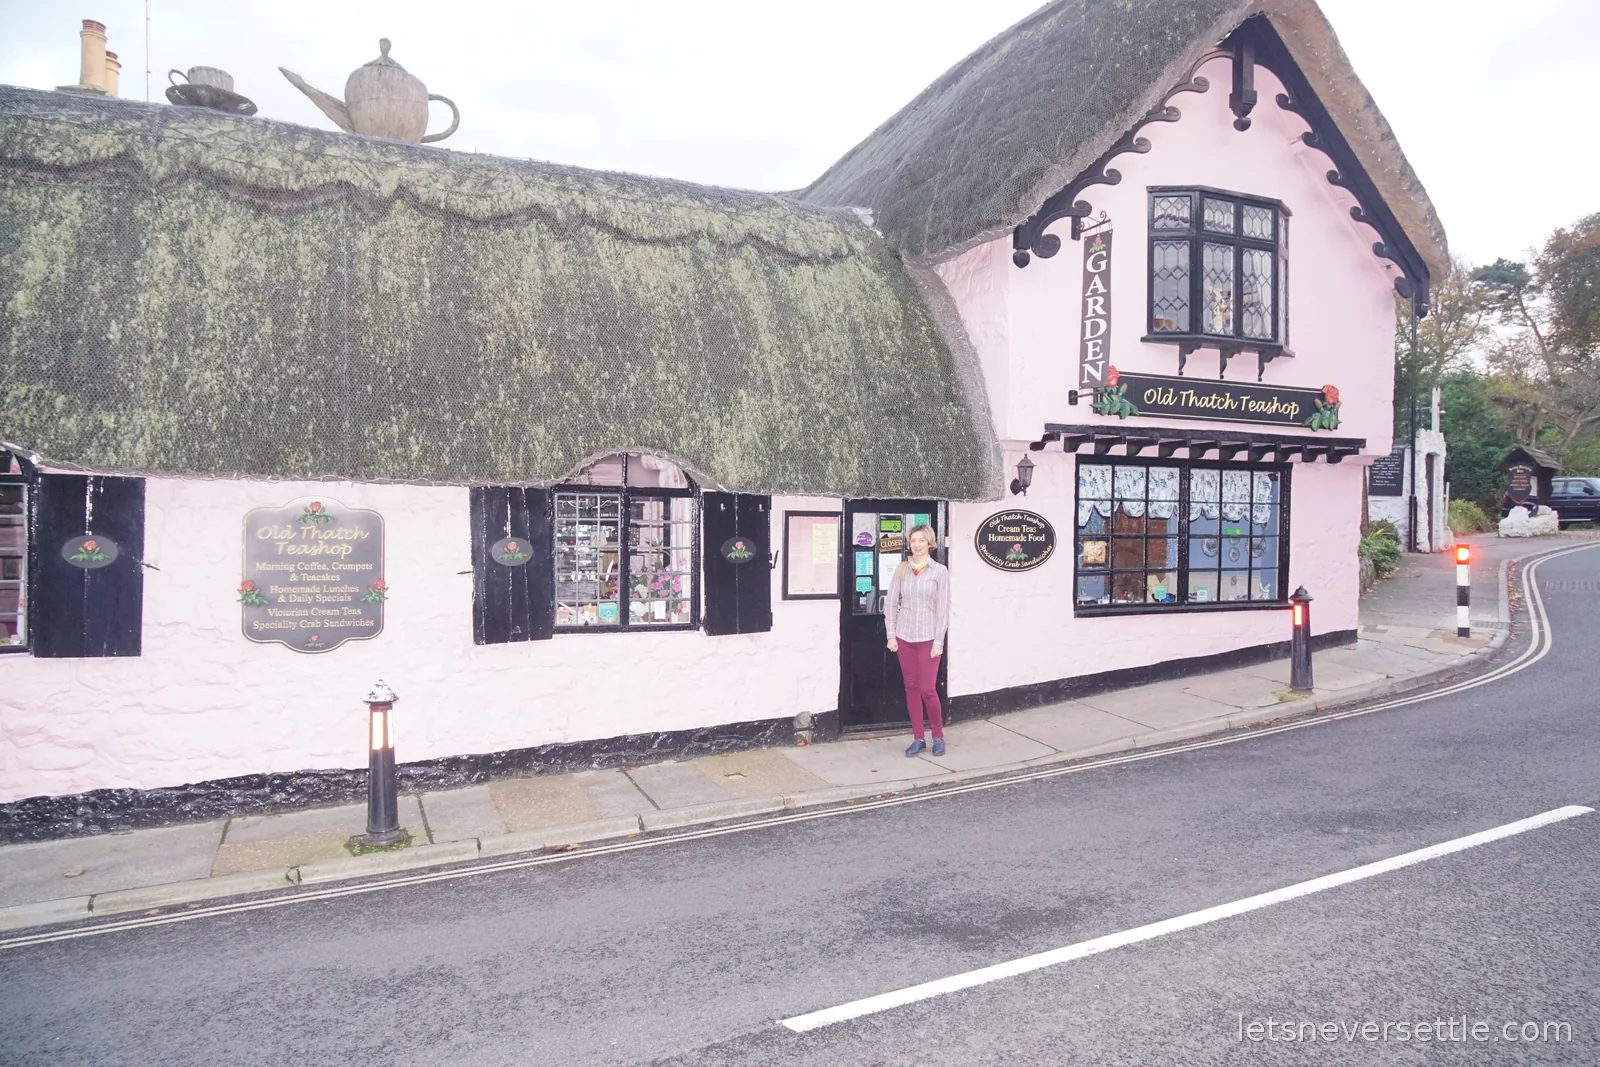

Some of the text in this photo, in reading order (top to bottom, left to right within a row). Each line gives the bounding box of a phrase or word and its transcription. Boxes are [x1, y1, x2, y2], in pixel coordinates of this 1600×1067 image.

[1081, 250, 1108, 384] GARDEN
[1143, 387, 1300, 420] Old Thatch Teashop
[989, 513, 1046, 529] Old Thatch Teashop
[256, 524, 370, 540] Old Thatch
[997, 524, 1037, 533] Cream Teas
[988, 533, 1046, 542] Homemade Food
[880, 539, 903, 548] CLOSED
[275, 540, 353, 560] Teashop
[980, 544, 1005, 567] Speciality
[1004, 560, 1021, 568] Crab
[255, 562, 373, 572] Morning Coffee, Crumpets
[289, 573, 341, 582] & Teacakes
[269, 585, 360, 594] Homemade Lunches
[277, 593, 352, 604] & Daily Specials
[267, 607, 362, 617] Victorian Cream Teas
[253, 619, 374, 631] Speciality Crab Sandwiches
